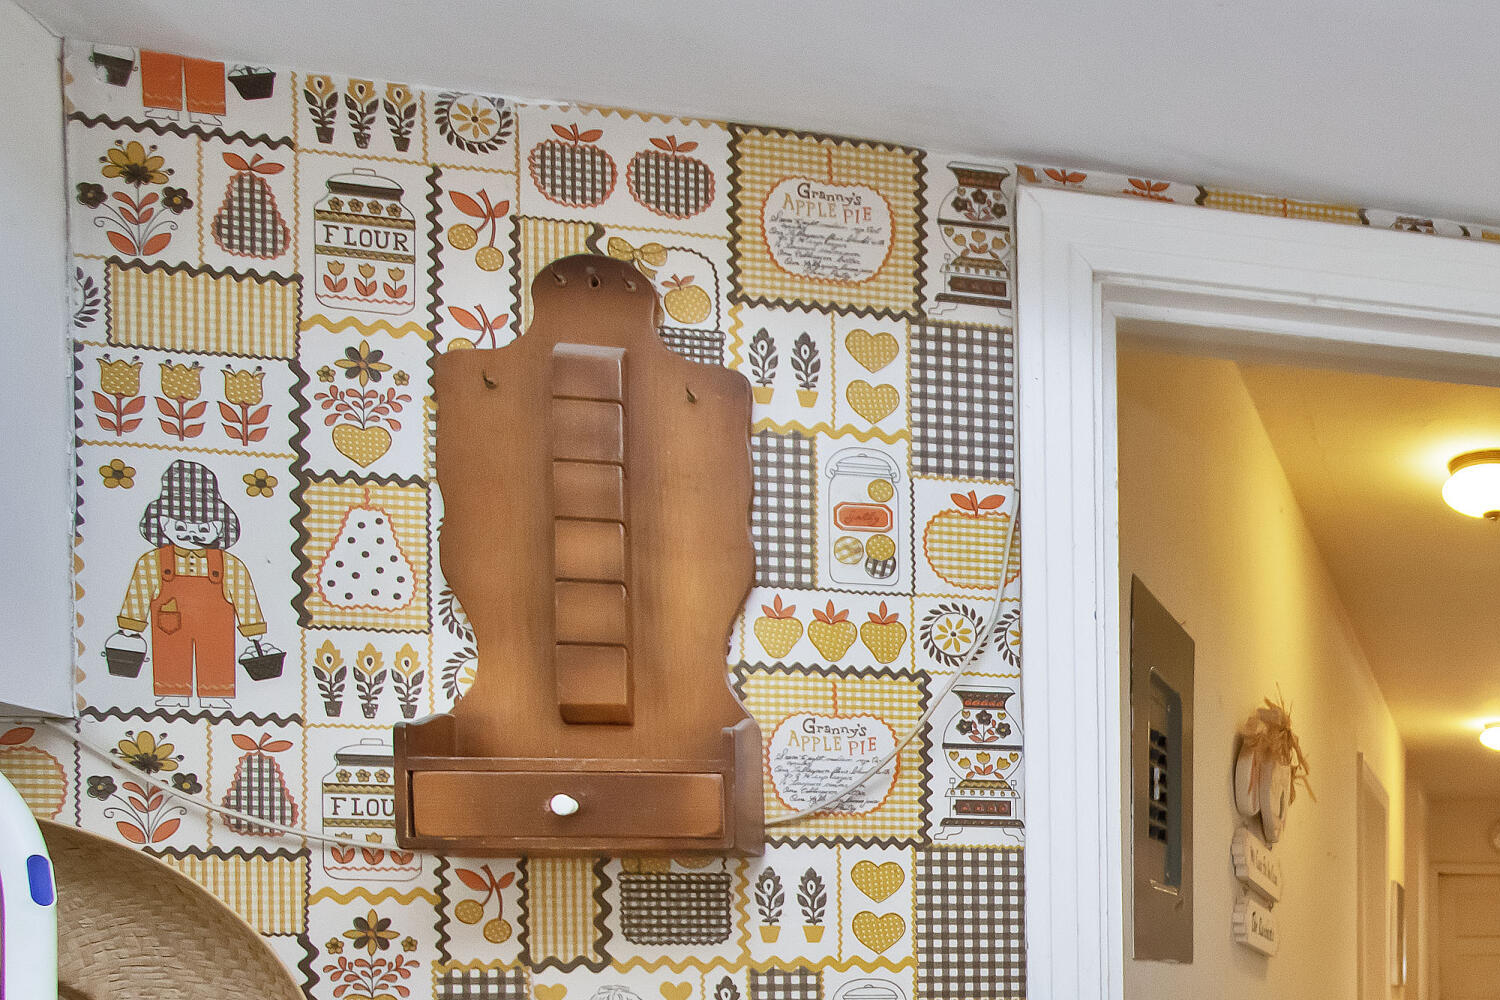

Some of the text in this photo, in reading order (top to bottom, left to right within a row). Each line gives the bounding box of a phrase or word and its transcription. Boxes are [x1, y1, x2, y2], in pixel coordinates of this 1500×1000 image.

[797, 182, 862, 206] Granny's
[783, 193, 872, 224] APPLE PIE
[322, 223, 409, 252] FLOUR
[802, 717, 867, 738] Granny's
[787, 730, 877, 756] APPLE PIE
[330, 796, 395, 817] FLOU
